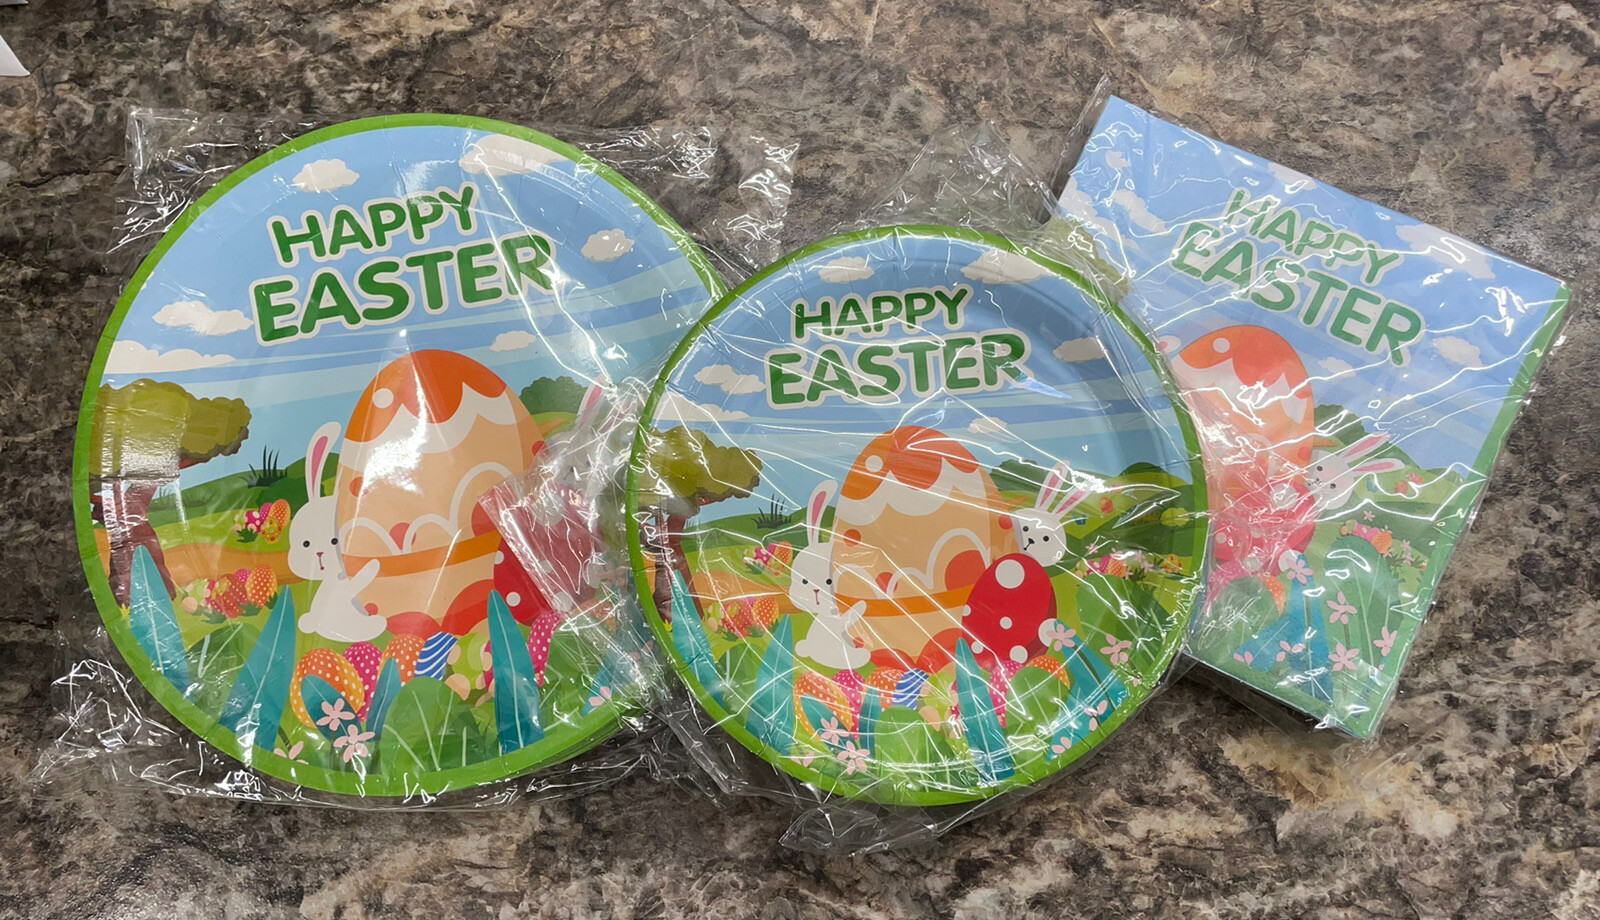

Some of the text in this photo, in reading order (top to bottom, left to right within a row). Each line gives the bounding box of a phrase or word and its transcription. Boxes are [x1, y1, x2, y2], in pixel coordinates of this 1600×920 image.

[271, 185, 475, 264] HAPPY
[1225, 189, 1400, 284] HAPPY
[253, 233, 554, 342] EASTER
[794, 287, 968, 339] HAPPY
[1171, 221, 1422, 366] EASTER
[768, 333, 1028, 405] EASTER
